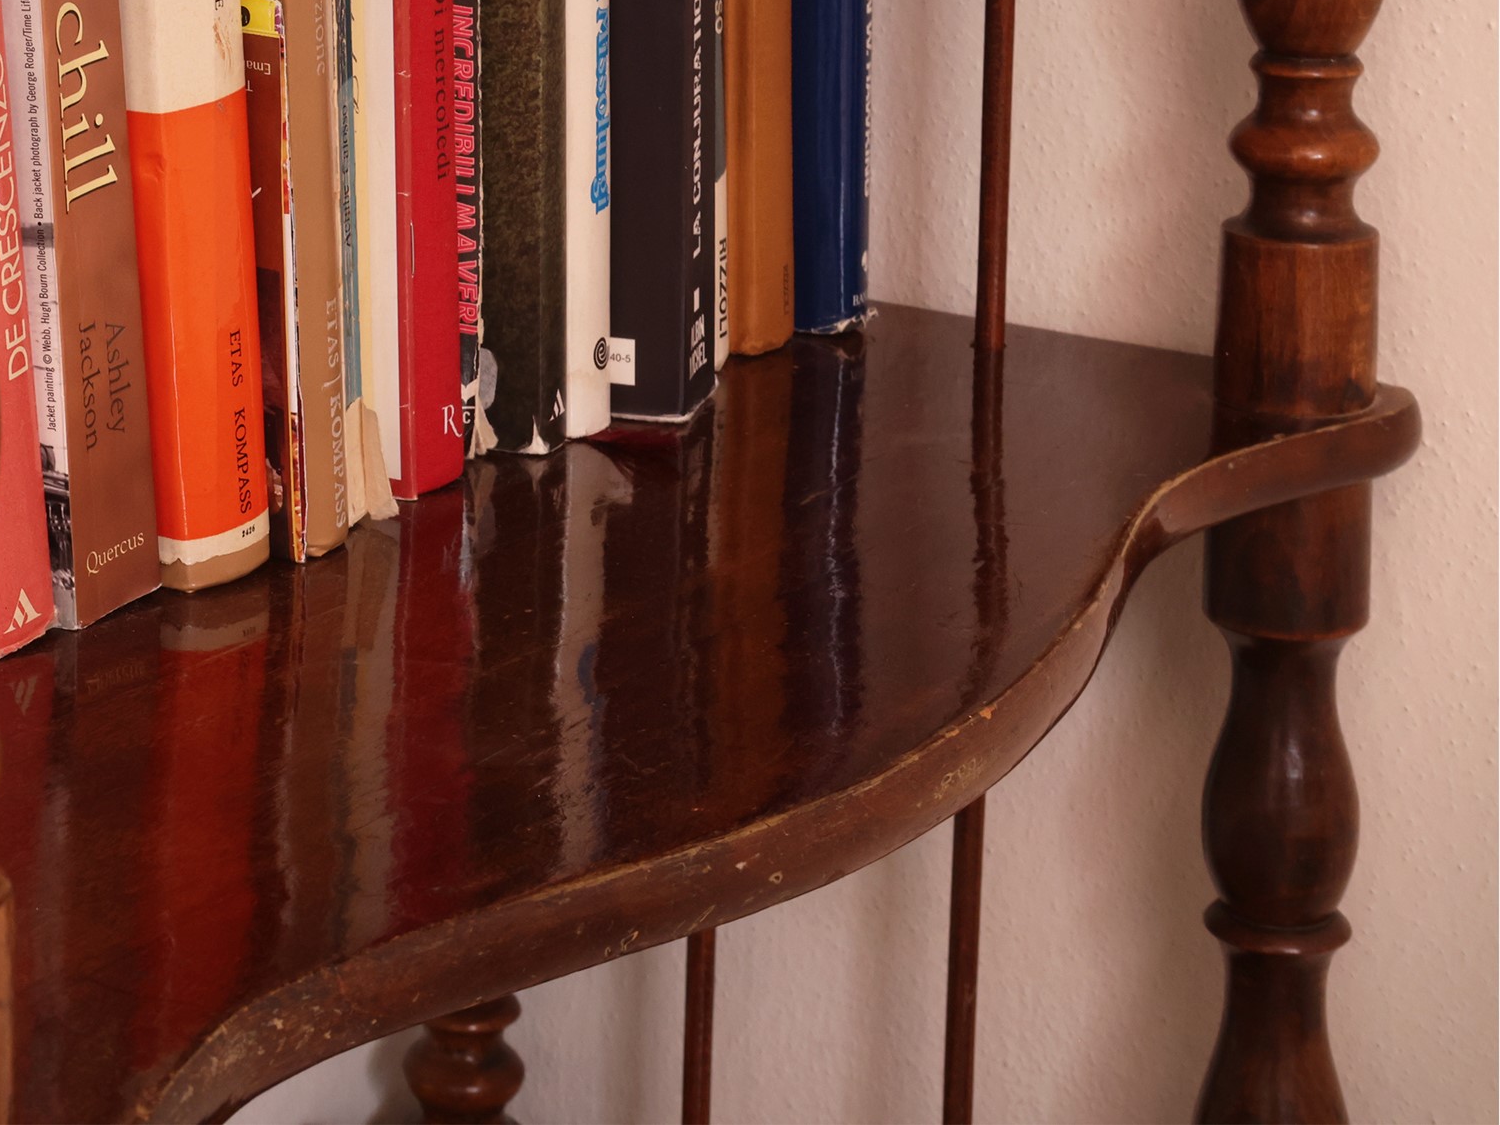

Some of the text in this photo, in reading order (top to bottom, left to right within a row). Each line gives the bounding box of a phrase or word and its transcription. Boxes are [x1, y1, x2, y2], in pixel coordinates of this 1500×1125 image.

[26, 71, 37, 102] George
[28, 116, 42, 167] photograph
[32, 169, 44, 196] jacket
[33, 198, 44, 219] Back
[456, 205, 476, 260] MA
[36, 228, 47, 272] Collection
[692, 211, 703, 261] LA
[38, 273, 49, 299] Bourn
[458, 263, 477, 336] VERI
[719, 236, 728, 340] RIZZOLI
[40, 300, 51, 325] Hugh
[8, 325, 30, 381] DE
[44, 366, 56, 401] painting
[78, 321, 99, 452] Jackson
[104, 320, 127, 436] Ashley
[46, 401, 58, 432] Jacket
[229, 328, 254, 515] ETAS KOMPASS
[324, 297, 345, 531] ETAS KOMPASS
[85, 530, 146, 577] Quercus
[241, 523, 257, 539] 2426
